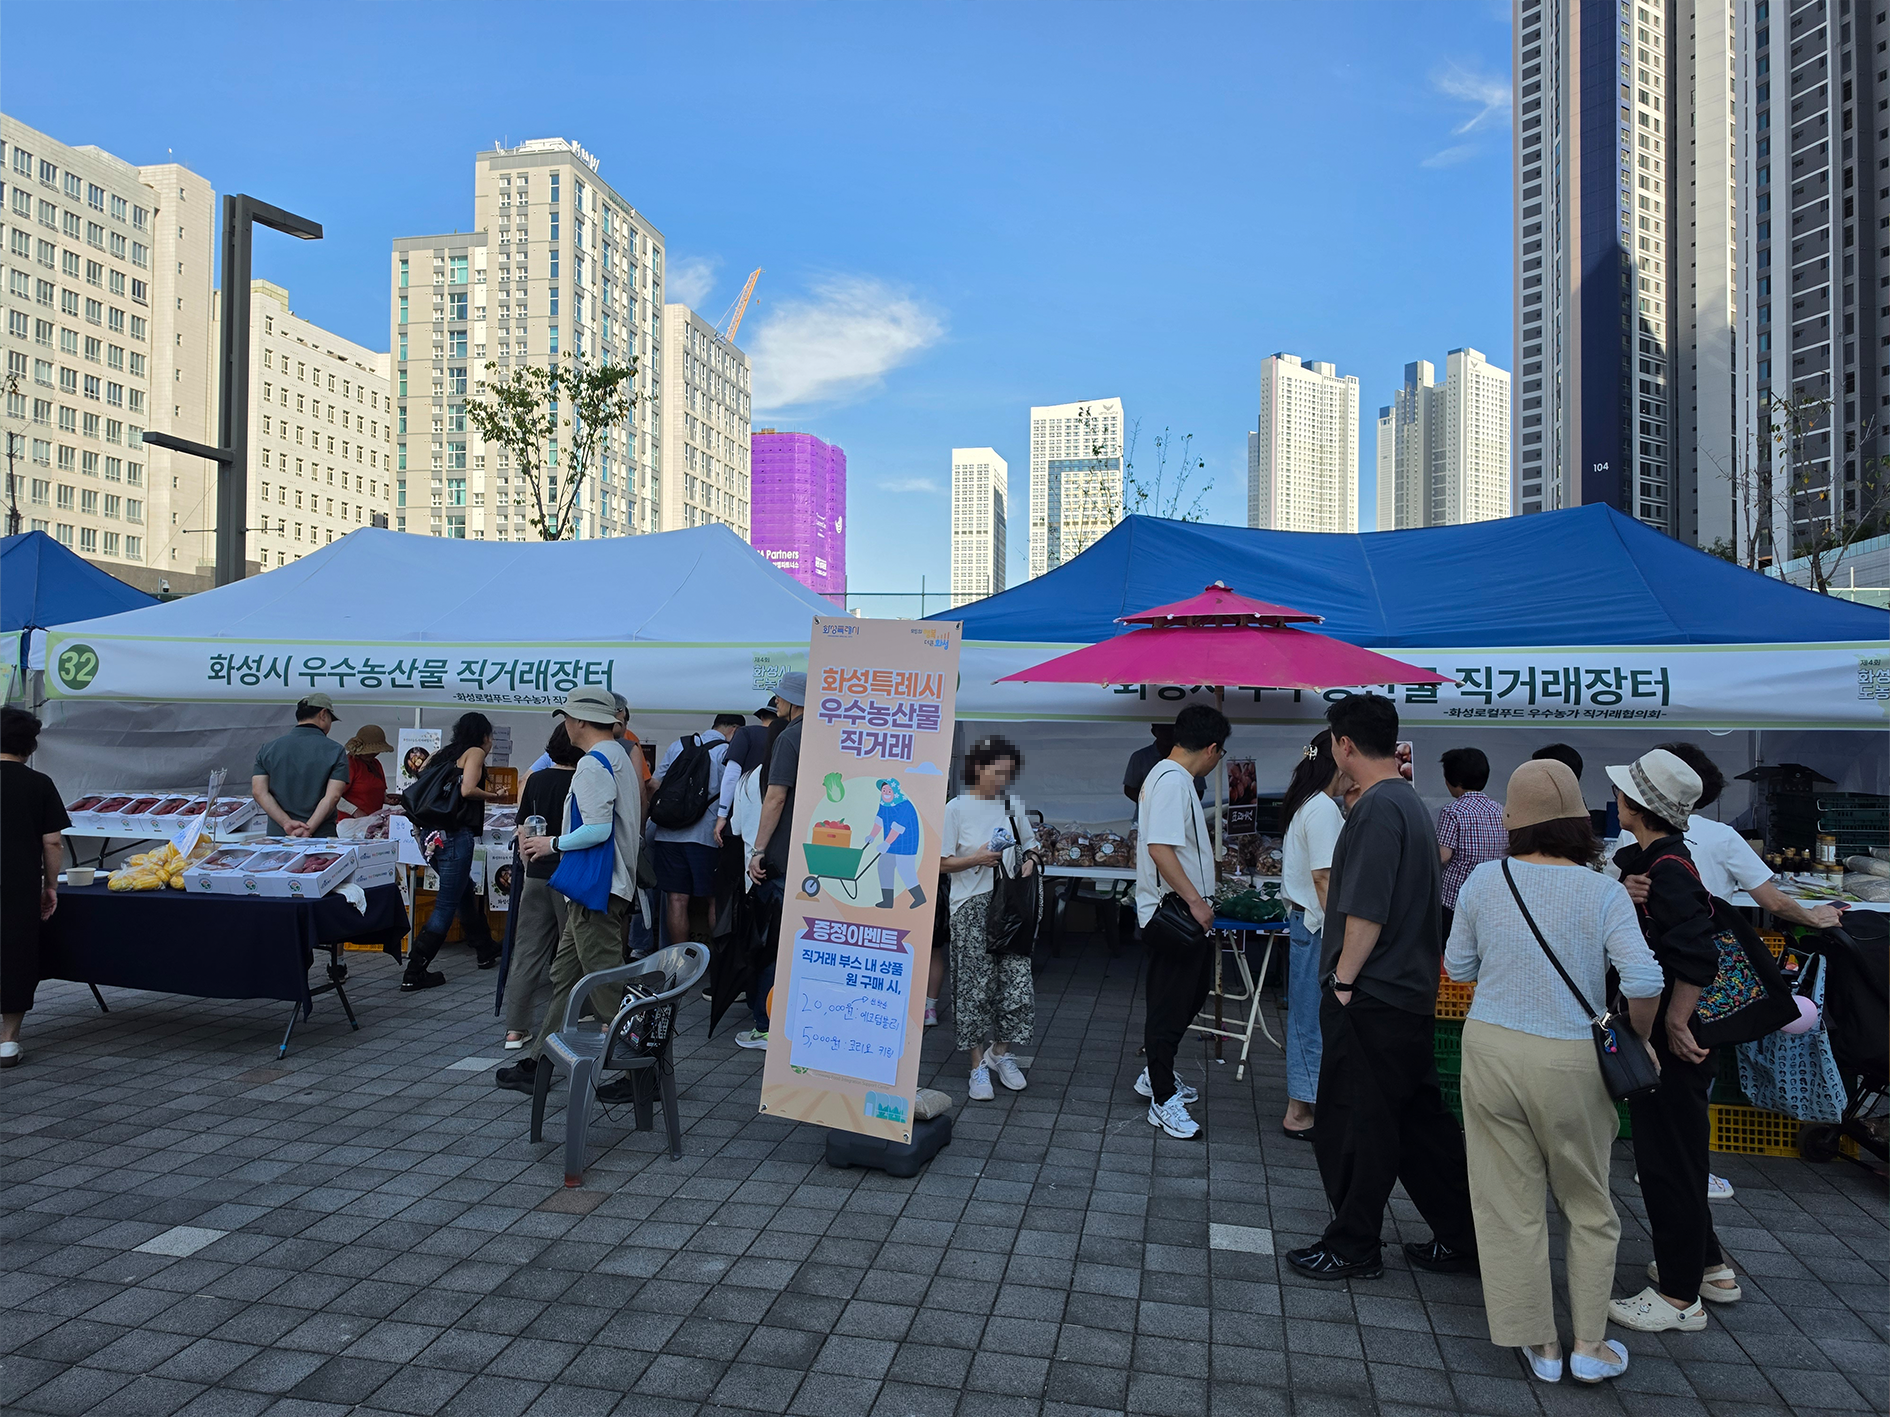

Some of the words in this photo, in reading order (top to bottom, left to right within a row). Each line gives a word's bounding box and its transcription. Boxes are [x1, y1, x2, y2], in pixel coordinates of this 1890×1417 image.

[1593, 462, 1609, 472] 104
[766, 549, 799, 560] Partners
[60, 651, 97, 682] 32
[207, 653, 293, 687] 화성시
[298, 655, 448, 690] 우수농산물
[456, 659, 615, 692] 직거래장터
[752, 678, 782, 691] 도농
[820, 667, 945, 700] 화성특례시
[1455, 666, 1670, 706] 직거래장터
[513, 694, 552, 705] 우수농가
[817, 697, 942, 732] 우수농산물
[1443, 708, 1525, 719] -화성로컬푸드
[1527, 708, 1581, 719] 우수농가
[1583, 709, 1667, 719] 직거래협의회-
[839, 730, 915, 761] 직거래
[813, 919, 899, 950] 증정이벤트
[802, 949, 837, 967] 직거래
[839, 954, 863, 970] 부스
[865, 958, 878, 973] 내
[880, 960, 904, 977] 상품
[845, 972, 858, 987] 원
[860, 975, 885, 991] 구매
[886, 979, 901, 995] 시,
[878, 1045, 894, 1059] 키링
[862, 1080, 877, 1088] Support
[877, 1082, 890, 1090] Center
